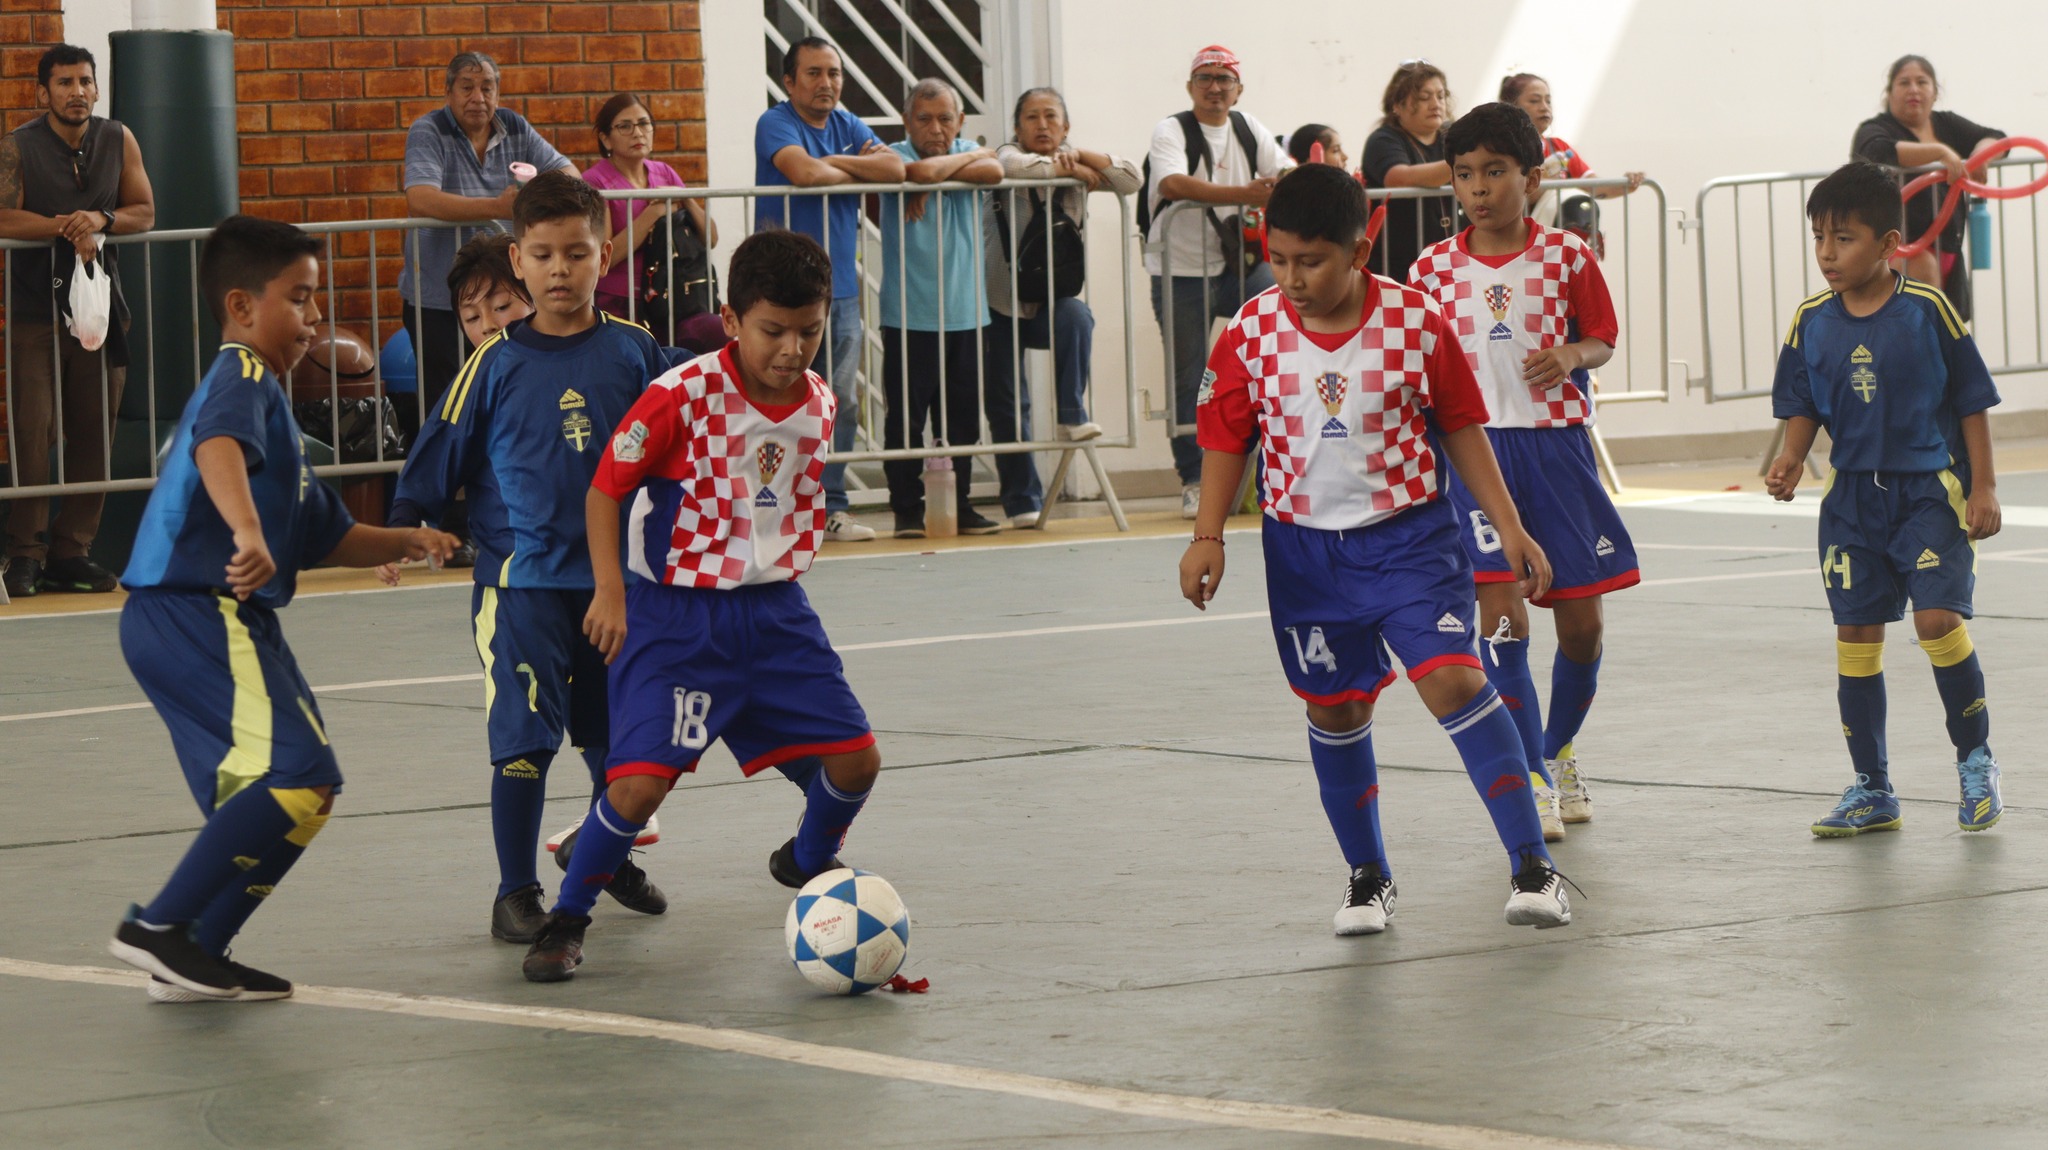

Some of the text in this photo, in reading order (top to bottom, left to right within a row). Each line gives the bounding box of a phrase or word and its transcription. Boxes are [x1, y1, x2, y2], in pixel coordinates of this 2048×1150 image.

[1822, 544, 1852, 590] 14
[1284, 625, 1338, 676] 14
[670, 686, 712, 750] 18
